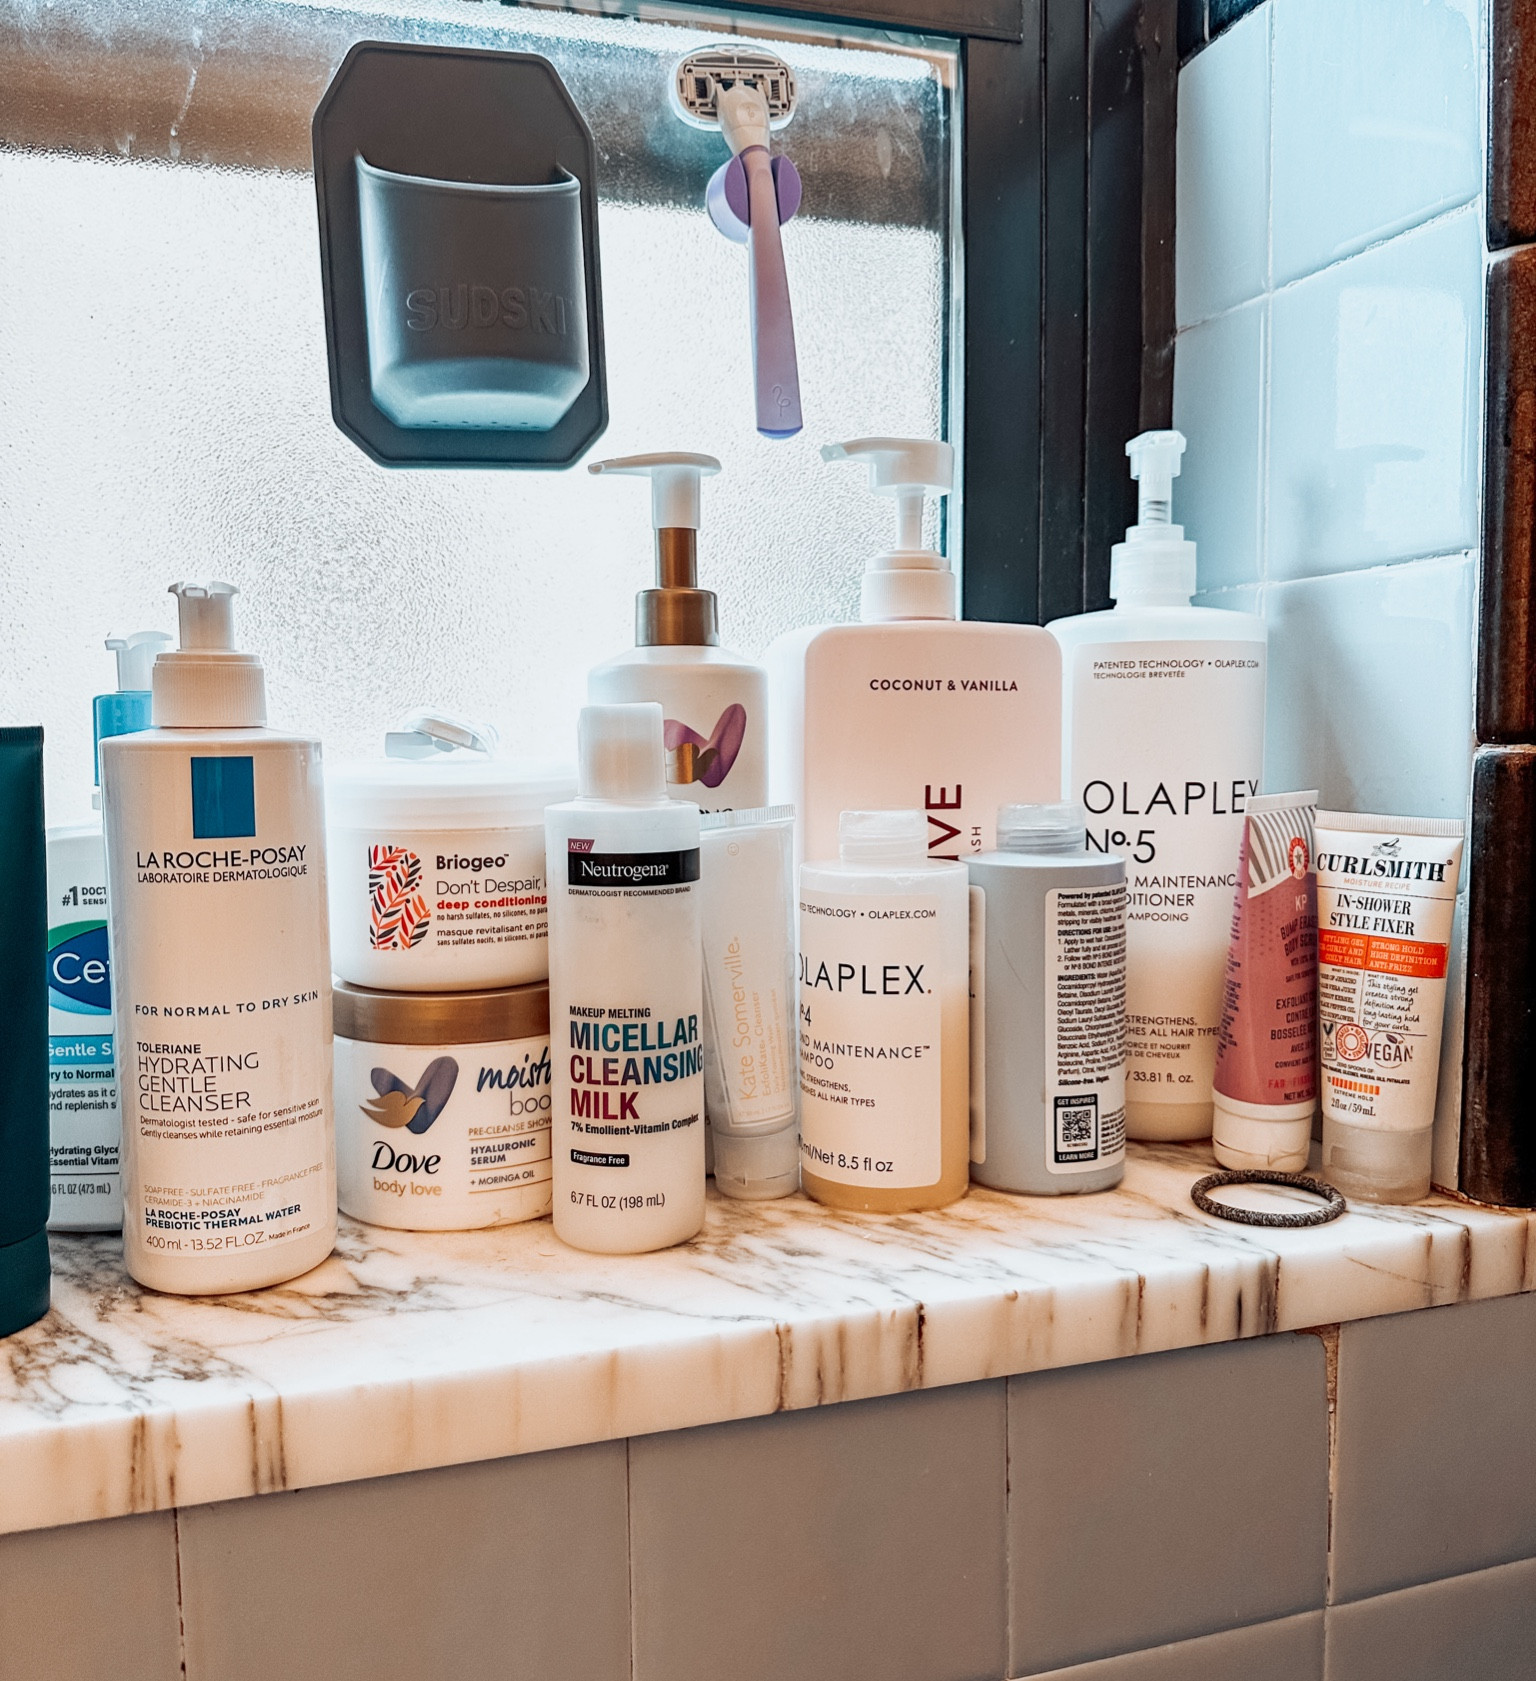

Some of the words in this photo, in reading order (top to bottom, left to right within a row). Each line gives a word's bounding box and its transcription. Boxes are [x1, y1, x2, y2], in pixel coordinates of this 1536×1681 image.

[1094, 660, 1136, 670] PATENTED
[1138, 660, 1204, 669] TECHNOLOGY
[1094, 672, 1146, 680] TECHNOLOGIE
[1148, 670, 1186, 678] BREVETÉE
[870, 679, 942, 691] COCONUT
[947, 680, 956, 691] &
[961, 680, 1018, 692] VANILLA
[570, 842, 590, 850] NEW
[137, 851, 160, 868] LA
[164, 844, 306, 868] ROCHE-POSAY
[138, 872, 210, 884] LABORATOIRE
[213, 864, 308, 882] DERMATOLOGIQUE
[580, 860, 668, 881] Neutrogena
[1317, 852, 1446, 882] CURLSMITH
[436, 880, 480, 895] Don't
[485, 876, 540, 894] Despair,
[568, 888, 622, 897] DERMATOLOGIST
[624, 888, 674, 897] RECOMMENDED
[675, 886, 690, 894] BRAND
[1344, 878, 1383, 888] MOISTURE
[1384, 882, 1411, 890] RECIPE
[437, 900, 470, 910] deep
[474, 895, 547, 908] conditioning
[1336, 894, 1411, 916] IN-SHOWER
[446, 912, 464, 920] harsh
[466, 912, 492, 920] sulfates,
[807, 904, 856, 918] TECHNOLOGY
[868, 910, 936, 919] OLAPLEX.COM
[437, 929, 473, 938] masque
[476, 925, 522, 934] revitalisant
[1330, 912, 1370, 930] STYLE
[1372, 916, 1415, 936] FIXER
[1323, 934, 1350, 945] STYLING
[1350, 937, 1364, 946] GEL
[1372, 942, 1400, 952] STRONG
[1402, 945, 1424, 954] HOLD
[1348, 948, 1363, 956] AND
[1370, 951, 1388, 960] HIGH
[1390, 954, 1438, 966] DEFINITION
[52, 952, 110, 984] Ce
[1344, 957, 1362, 965] HAIR
[724, 943, 751, 1048] Somerville
[1367, 979, 1381, 988] This
[1383, 984, 1406, 995] styling
[1407, 987, 1418, 996] gel
[136, 1004, 158, 1016] FOR
[164, 1005, 230, 1016] NORMAL
[236, 1002, 256, 1013] TO
[262, 997, 288, 1010] DRY
[294, 990, 318, 1004] SKIN
[1364, 998, 1394, 1010] definition
[1396, 1004, 1410, 1012] and
[1365, 992, 1388, 1000] creates
[1390, 994, 1414, 1005] strong
[570, 1006, 606, 1018] MAKEUP
[608, 1008, 651, 1018] MELTING
[752, 992, 764, 1036] Cleanser
[1404, 1014, 1420, 1022] hold
[1362, 1018, 1372, 1026] for
[570, 1014, 698, 1052] MICELLAR
[1150, 1028, 1167, 1037] ALL
[1171, 1028, 1194, 1037] HAIR
[137, 1042, 202, 1054] TOLERIANE
[1364, 1042, 1414, 1062] VEGAN
[138, 1052, 259, 1074] HYDRATING
[570, 1044, 704, 1086] CLEANSING
[63, 1069, 74, 1080] to
[76, 1068, 114, 1080] Normal
[738, 1055, 758, 1101] Kate
[1133, 1071, 1162, 1082] 33.81
[1178, 1074, 1194, 1083] oz.
[138, 1074, 216, 1094] GENTLE
[88, 1090, 99, 1098] as
[140, 1091, 252, 1112] CLEANSER
[817, 1092, 828, 1100] ALL
[830, 1094, 848, 1104] HAIR
[850, 1098, 876, 1108] TYPES
[1057, 1098, 1069, 1106] GET
[1070, 1096, 1095, 1104] INSPIRED
[1334, 1088, 1356, 1099] EXTREME
[65, 1100, 108, 1112] replenish
[570, 1088, 640, 1120] MILK
[140, 1116, 196, 1130] Dermatologist
[198, 1117, 228, 1127] tested
[237, 1114, 256, 1123] safe
[258, 1110, 271, 1120] for
[273, 1102, 306, 1118] sensitive
[308, 1098, 320, 1108] skin
[140, 1127, 161, 1140] Gently
[162, 1130, 198, 1139] cleanses
[200, 1129, 222, 1138] while
[224, 1124, 262, 1137] retaining
[264, 1117, 297, 1132] essential
[298, 1108, 324, 1122] moisture
[468, 1120, 525, 1136] PRE-CLEANSE
[571, 1121, 583, 1132] 7%
[585, 1122, 670, 1136] Emollient-Vitamin
[672, 1113, 699, 1130] Complex
[470, 1138, 536, 1155] HYALURONIC
[372, 1140, 441, 1174] Dove
[470, 1154, 506, 1166] SERUM
[573, 1152, 606, 1164] Fragrance
[608, 1156, 625, 1164] Free
[838, 1154, 858, 1170] 8.5
[875, 1160, 894, 1172] oz
[190, 1186, 230, 1197] SULFATE
[232, 1183, 255, 1194] FREE
[261, 1169, 308, 1188] FRAGRANCE
[308, 1162, 324, 1174] FREE
[478, 1172, 520, 1186] MORINGA
[522, 1170, 535, 1178] OIL
[68, 1184, 77, 1194] OZ
[78, 1183, 94, 1196] (473
[96, 1183, 110, 1195] mL)
[373, 1176, 406, 1198] body
[410, 1182, 442, 1196] love
[202, 1191, 265, 1207] NIACINAMIDE
[570, 1191, 584, 1204] 6.7
[586, 1194, 598, 1207] FL
[602, 1196, 616, 1208] OZ
[619, 1196, 643, 1211] (198
[646, 1193, 666, 1208] mL)
[146, 1207, 156, 1218] LA
[158, 1208, 241, 1220] ROCHE-POSAY
[146, 1218, 200, 1230] PREBIOTIC
[204, 1214, 263, 1230] THERMAL
[265, 1204, 301, 1220] WATER
[146, 1236, 166, 1249] 400
[167, 1238, 182, 1250] ml
[190, 1237, 223, 1250] 13.52
[268, 1232, 286, 1241] Made
[292, 1222, 310, 1236] France
